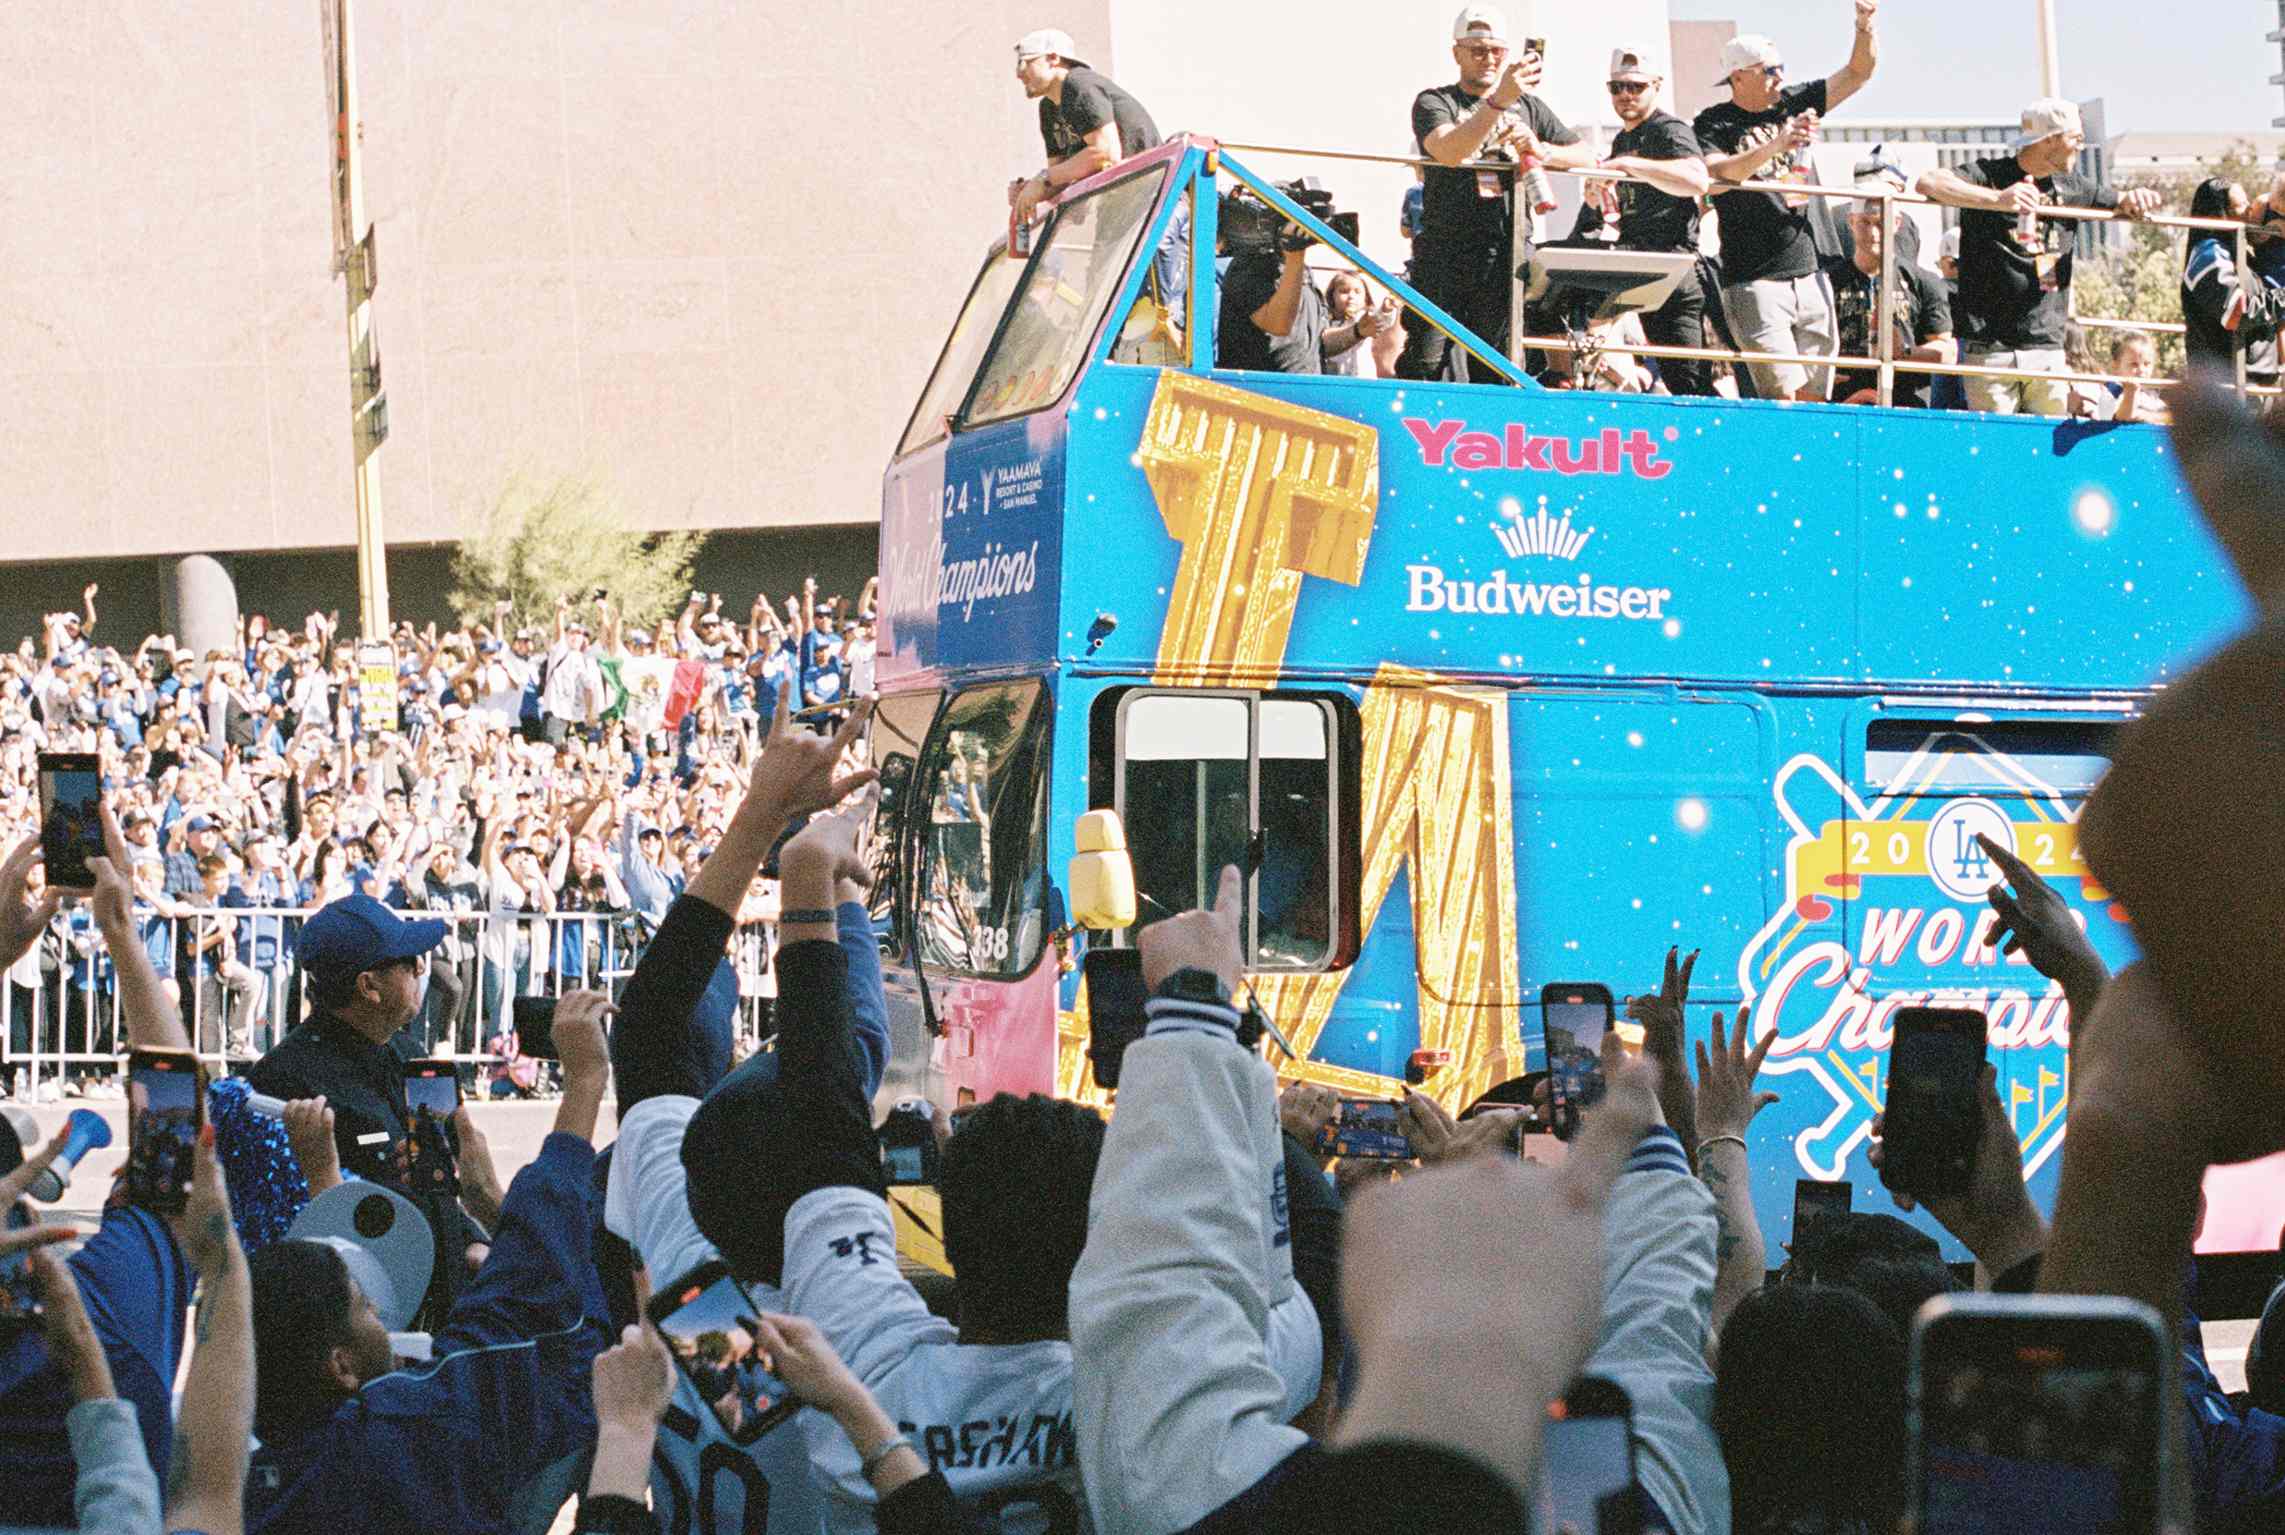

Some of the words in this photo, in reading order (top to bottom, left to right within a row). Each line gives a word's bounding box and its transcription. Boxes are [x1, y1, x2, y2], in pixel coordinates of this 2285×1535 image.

[1402, 417, 1673, 479] Yakult
[923, 531, 1039, 623] Champions
[1405, 565, 1671, 619] Budweiser
